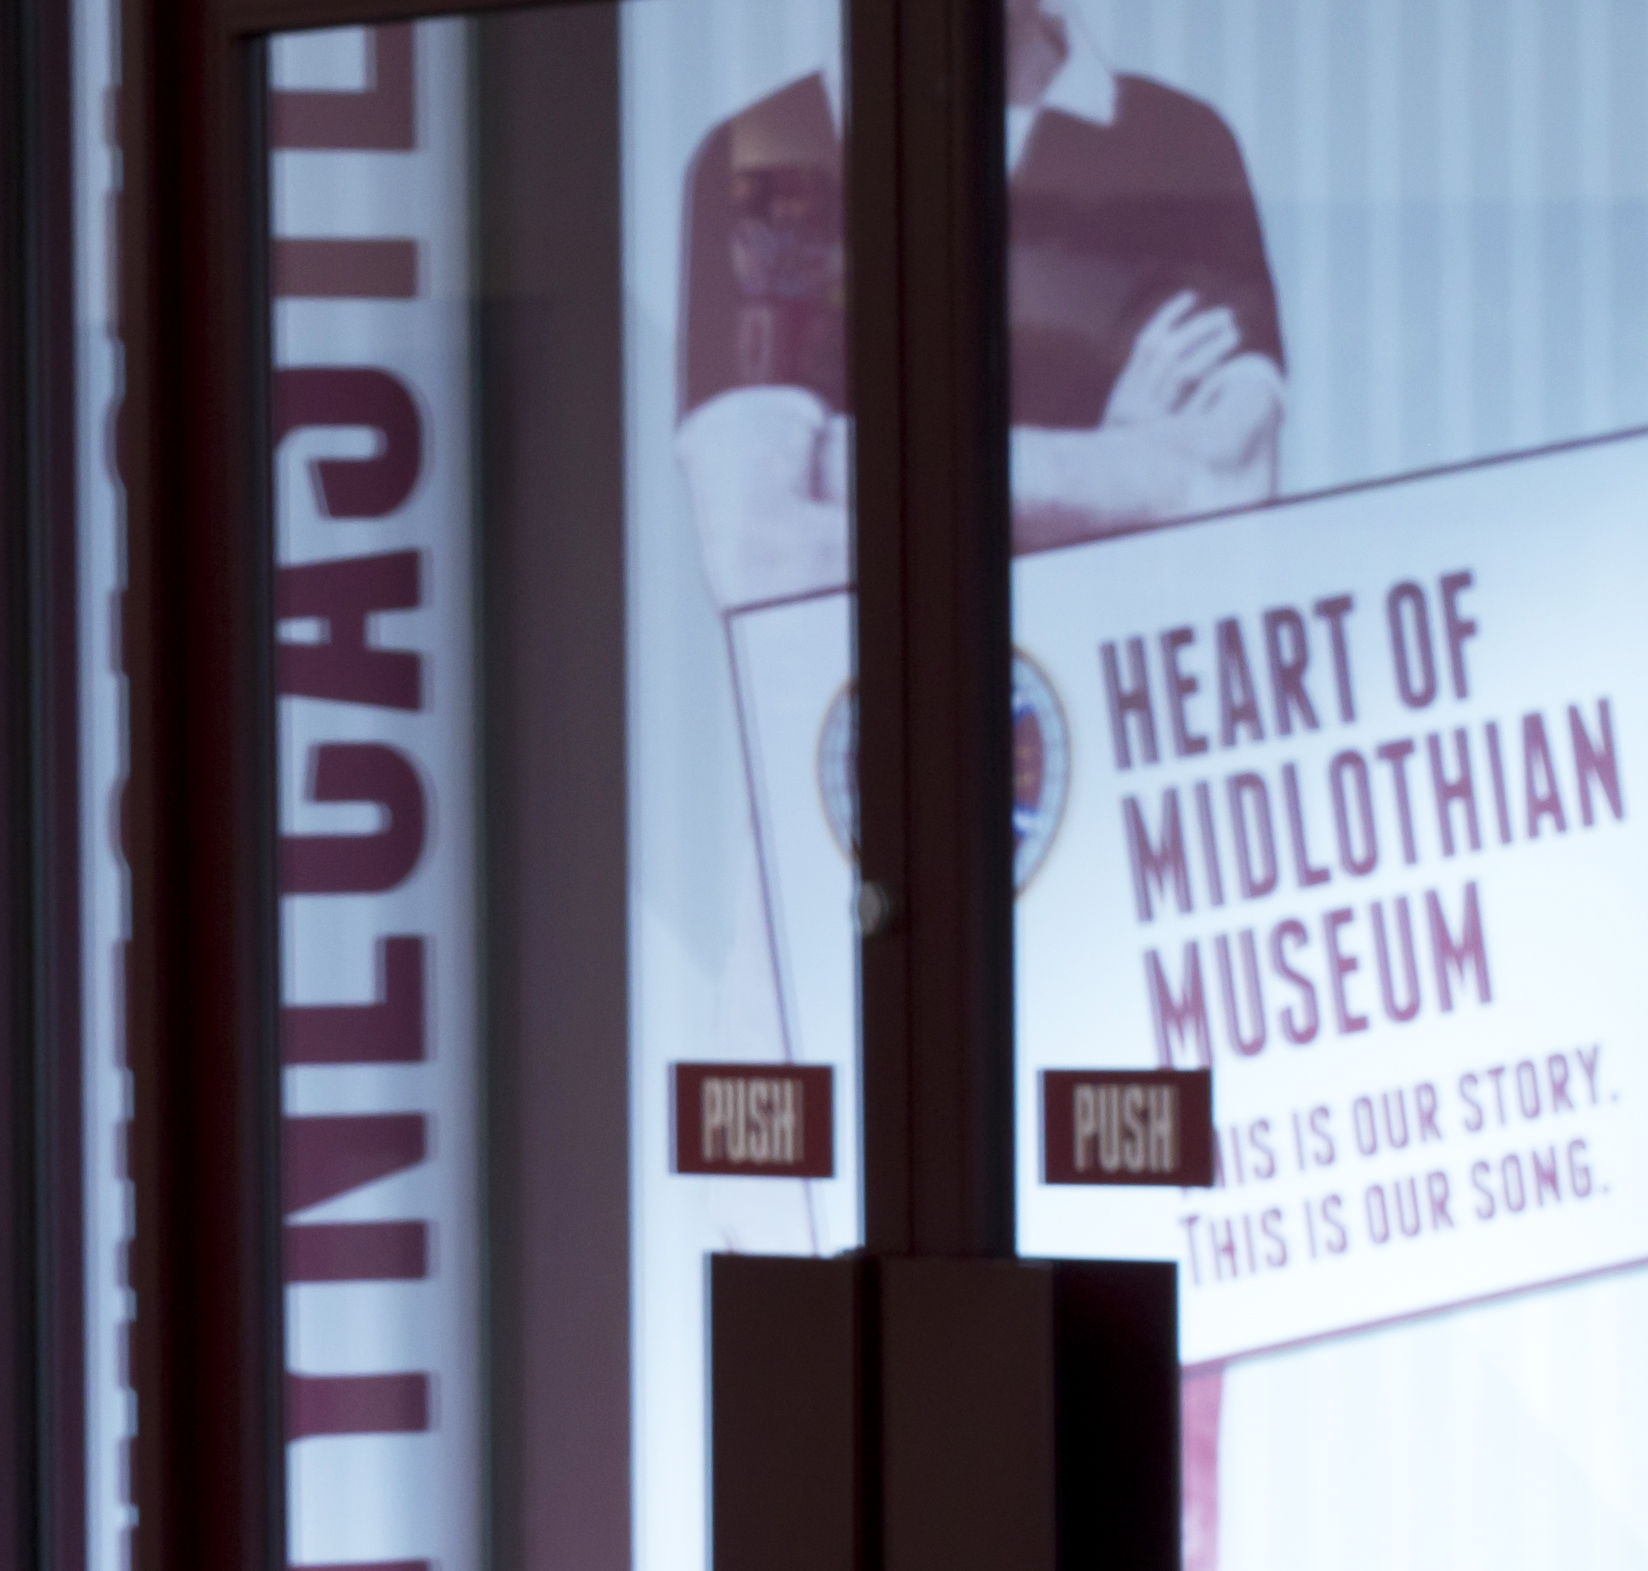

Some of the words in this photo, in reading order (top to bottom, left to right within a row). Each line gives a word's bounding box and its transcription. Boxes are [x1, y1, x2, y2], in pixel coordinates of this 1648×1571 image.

[1100, 593, 1357, 770] HEART
[1385, 569, 1478, 710] OF
[1119, 694, 1625, 923] MIDLOTHIAN
[1143, 879, 1495, 1069] MUSEUM
[701, 1075, 801, 1165] PUSH
[1072, 1083, 1178, 1173] PUSH
[1293, 1105, 1337, 1172] IS
[1352, 1080, 1442, 1157] OUR
[1458, 1044, 1621, 1134] STORY.
[1179, 1207, 1289, 1288] THIS
[1303, 1193, 1349, 1261] IS
[1364, 1169, 1456, 1245] OUR
[1470, 1137, 1612, 1223] SONG.
